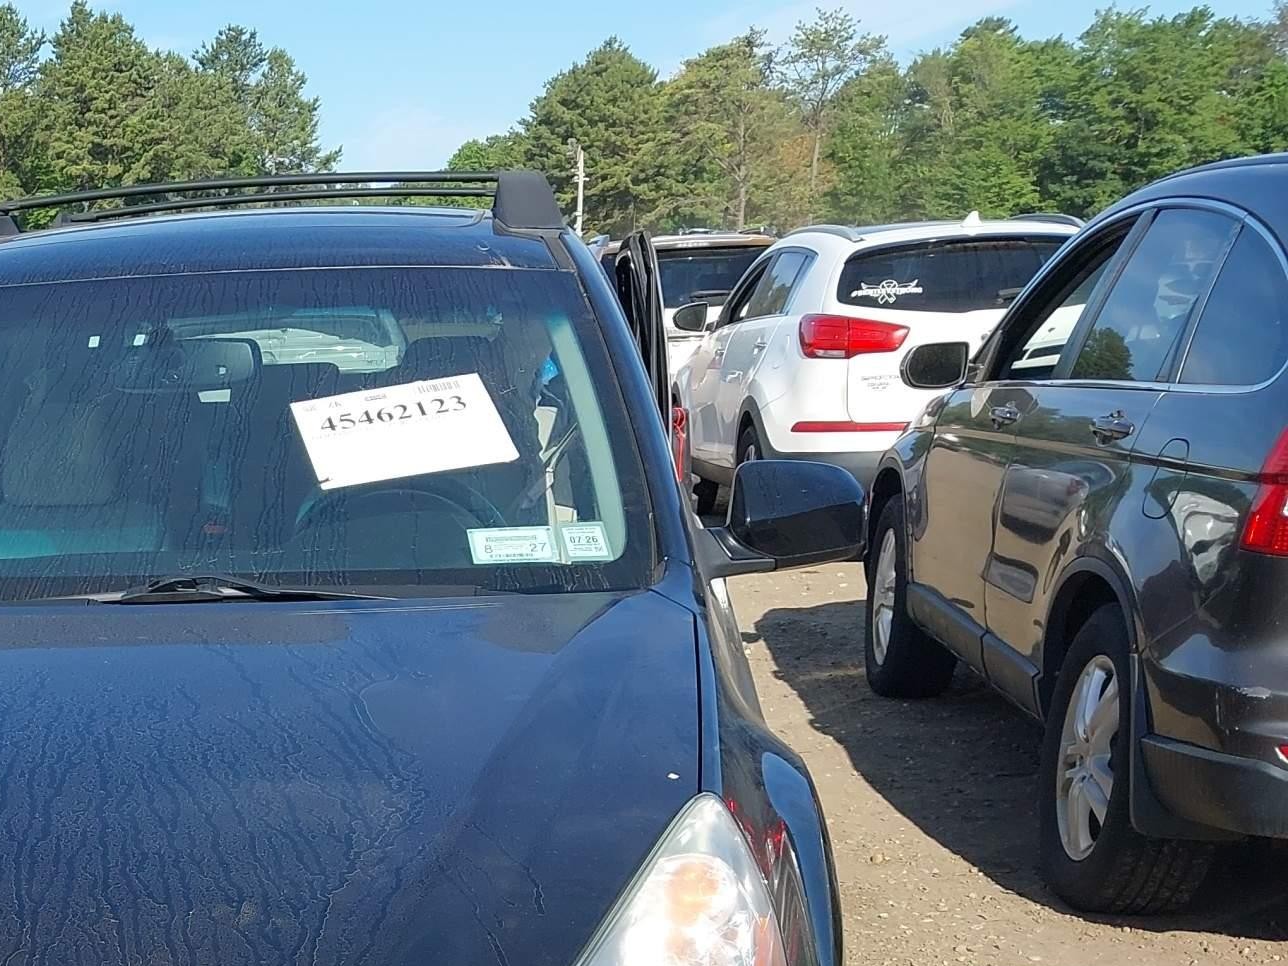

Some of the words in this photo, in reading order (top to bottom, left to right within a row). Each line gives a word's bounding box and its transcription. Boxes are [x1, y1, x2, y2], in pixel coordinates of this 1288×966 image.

[320, 395, 467, 431] 45462123
[585, 535, 598, 543] 26
[529, 542, 547, 553] 27
